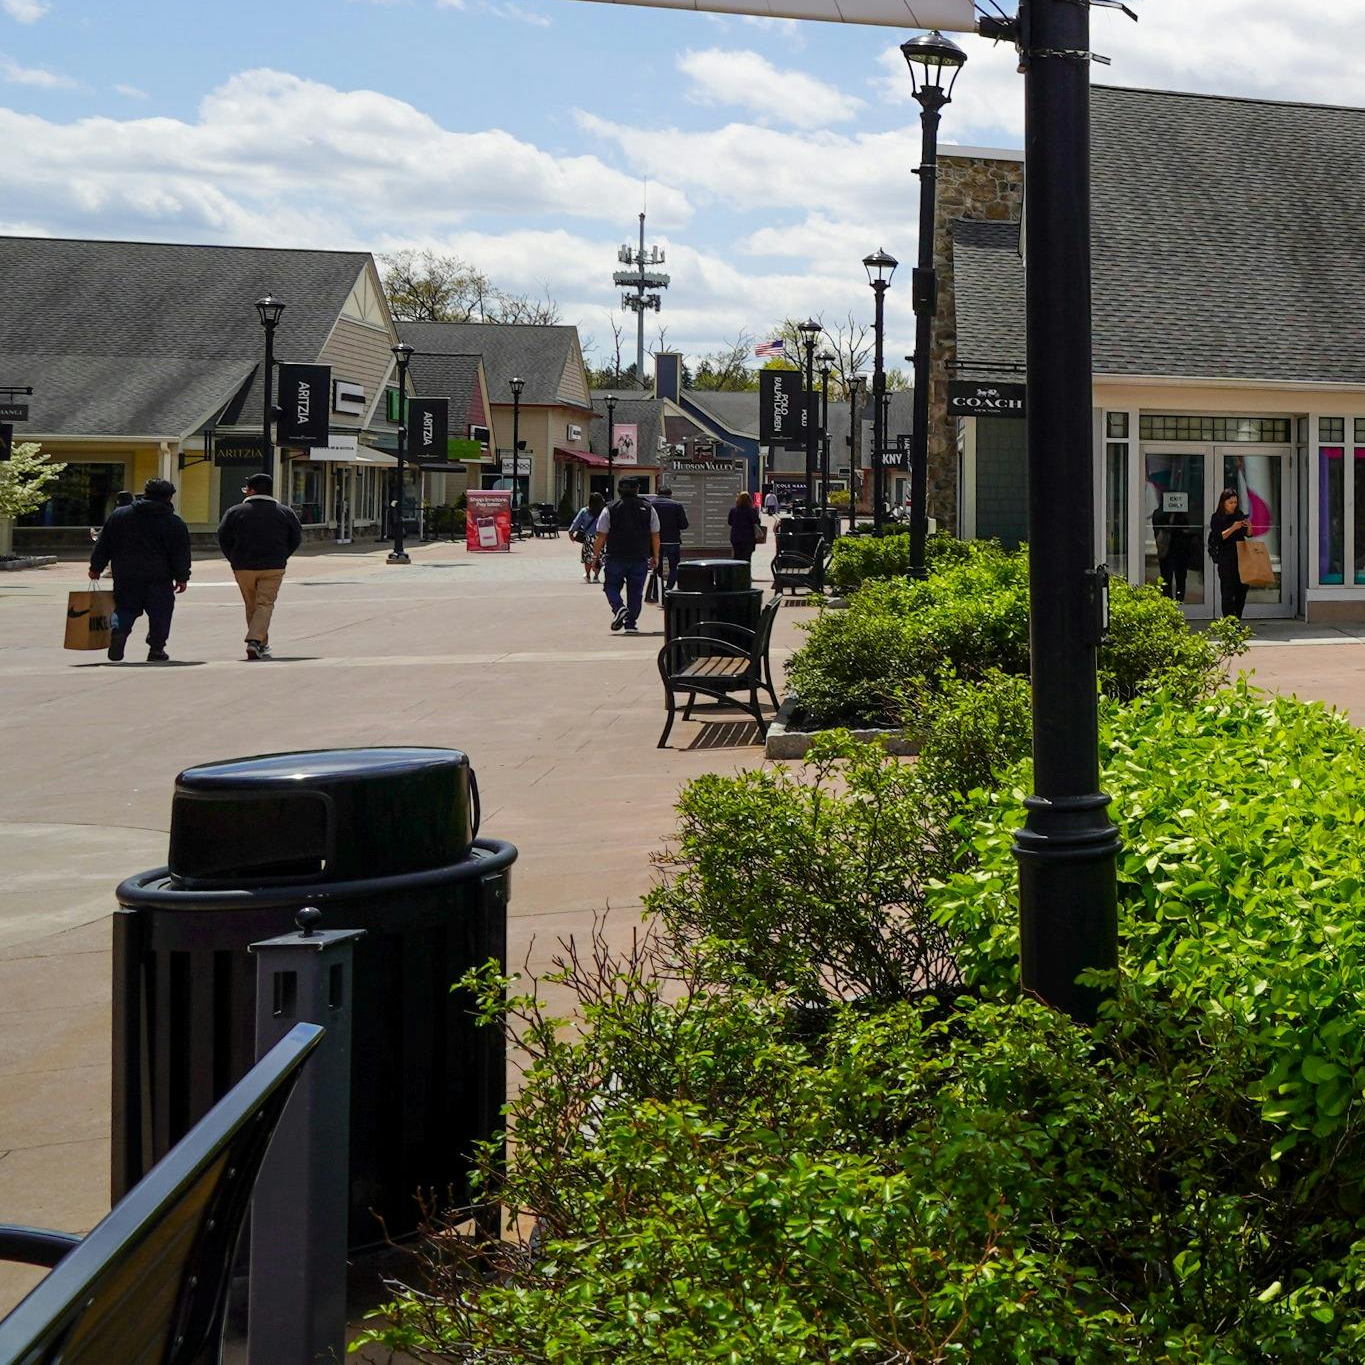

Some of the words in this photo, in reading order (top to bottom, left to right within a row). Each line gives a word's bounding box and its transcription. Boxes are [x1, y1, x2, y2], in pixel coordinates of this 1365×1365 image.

[773, 376, 782, 401] RALPH
[297, 380, 310, 425] ARITZIA
[781, 394, 789, 415] POLO
[952, 397, 1022, 409] COACH
[423, 411, 433, 446] ARITZIA
[773, 402, 782, 432] LAUREN
[216, 448, 263, 458] ARITZIA
[882, 454, 902, 465] KNY
